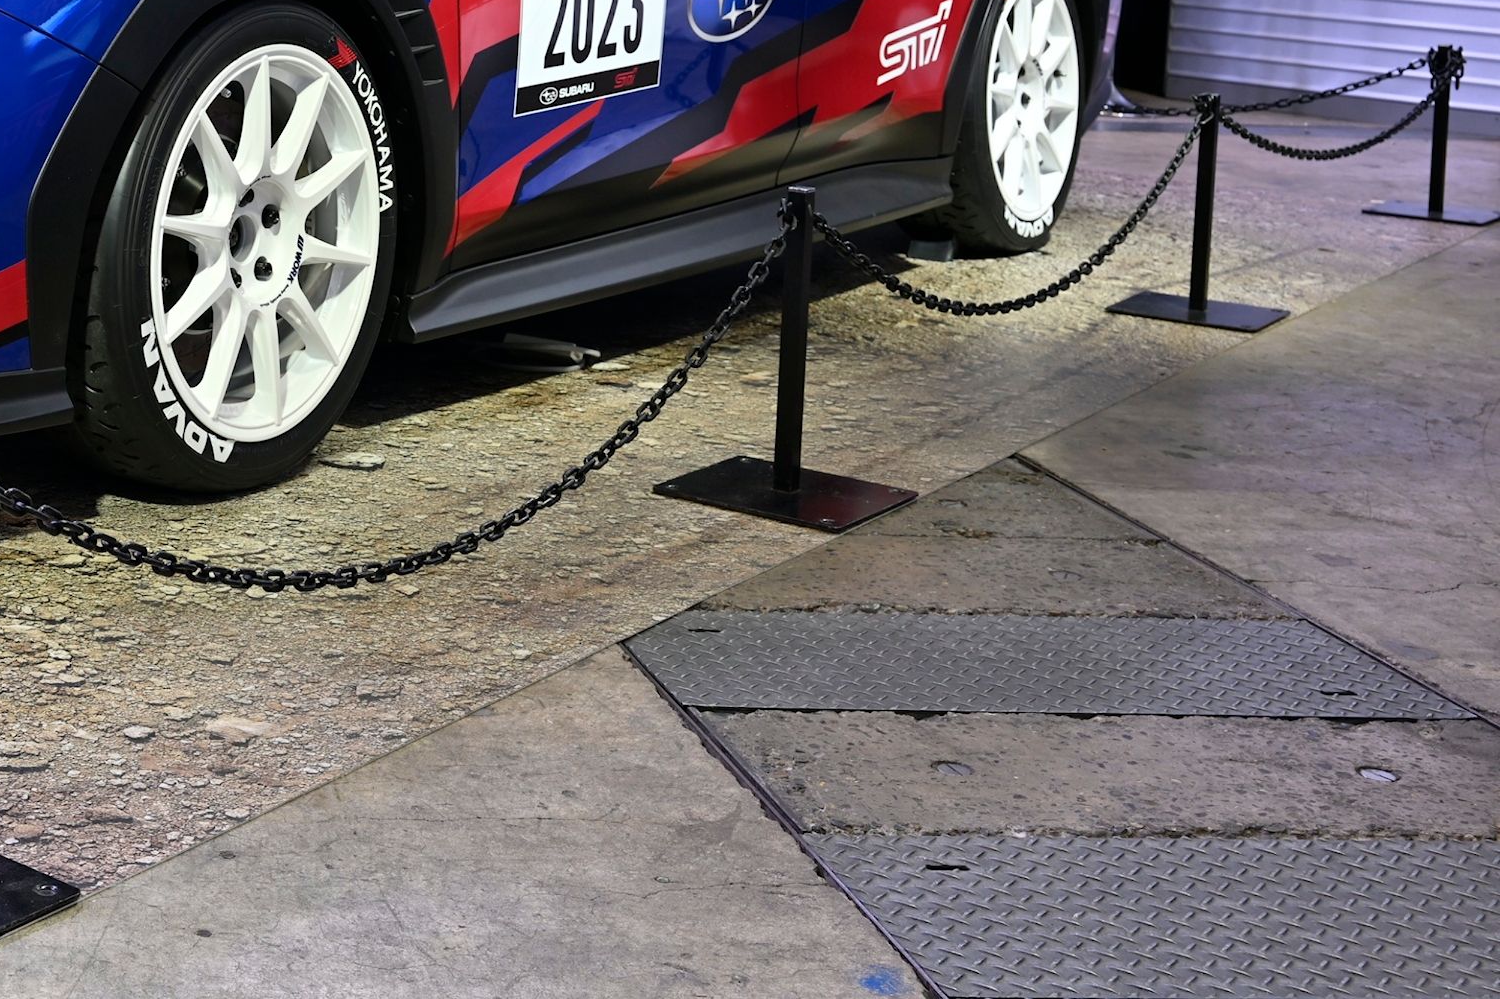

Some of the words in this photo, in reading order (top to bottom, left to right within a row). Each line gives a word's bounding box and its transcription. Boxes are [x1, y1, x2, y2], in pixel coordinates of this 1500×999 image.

[559, 82, 595, 99] SUBARU
[352, 60, 394, 213] YOKOHAMA
[1003, 204, 1054, 238] ADVAN
[286, 251, 303, 285] WORK
[140, 318, 237, 464] ADVAN
